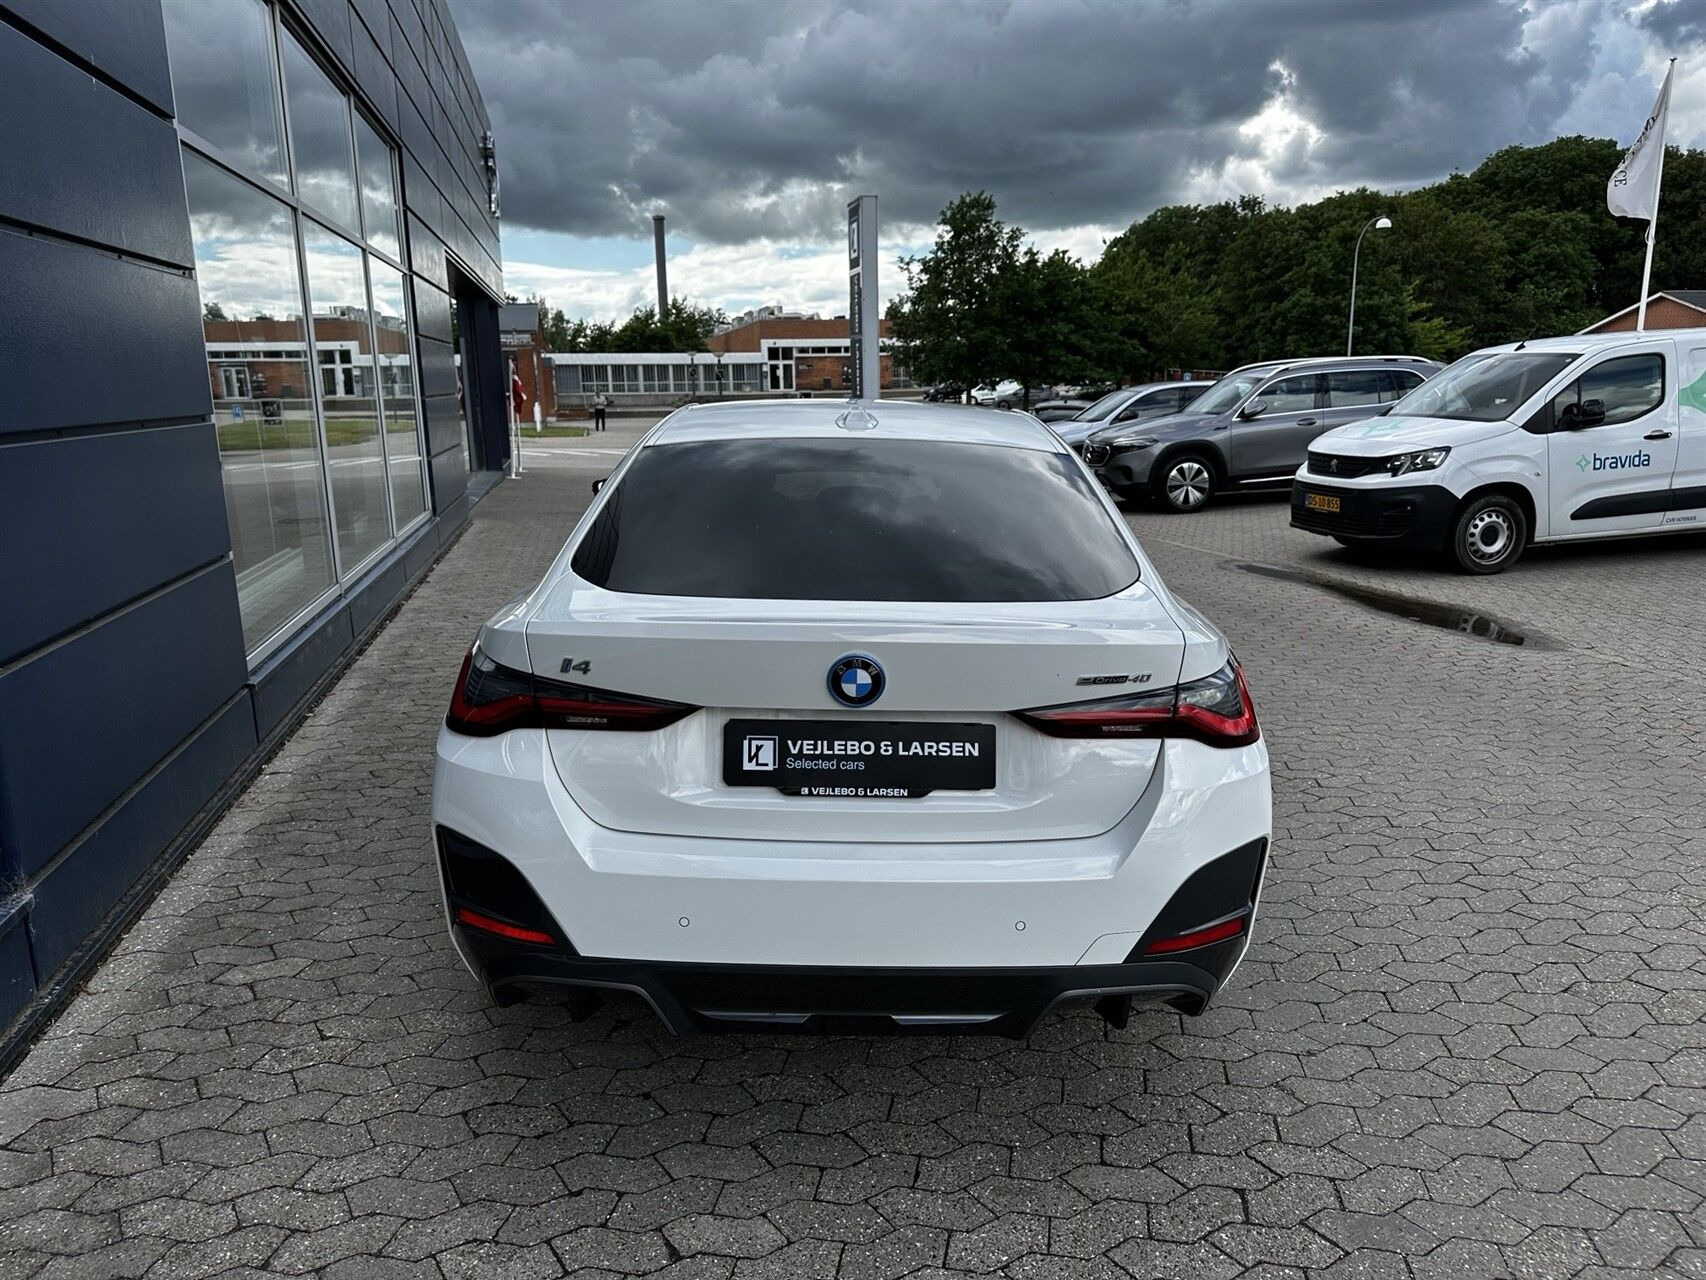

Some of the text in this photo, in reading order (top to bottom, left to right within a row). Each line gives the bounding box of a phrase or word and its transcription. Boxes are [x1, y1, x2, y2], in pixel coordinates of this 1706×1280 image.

[1593, 450, 1651, 471] bravida
[560, 657, 591, 675] i4
[787, 740, 979, 756] VEJLEBO & LARSEN
[786, 757, 865, 770] Selected cars
[811, 787, 908, 797] VEJLEBO & LARSEN
